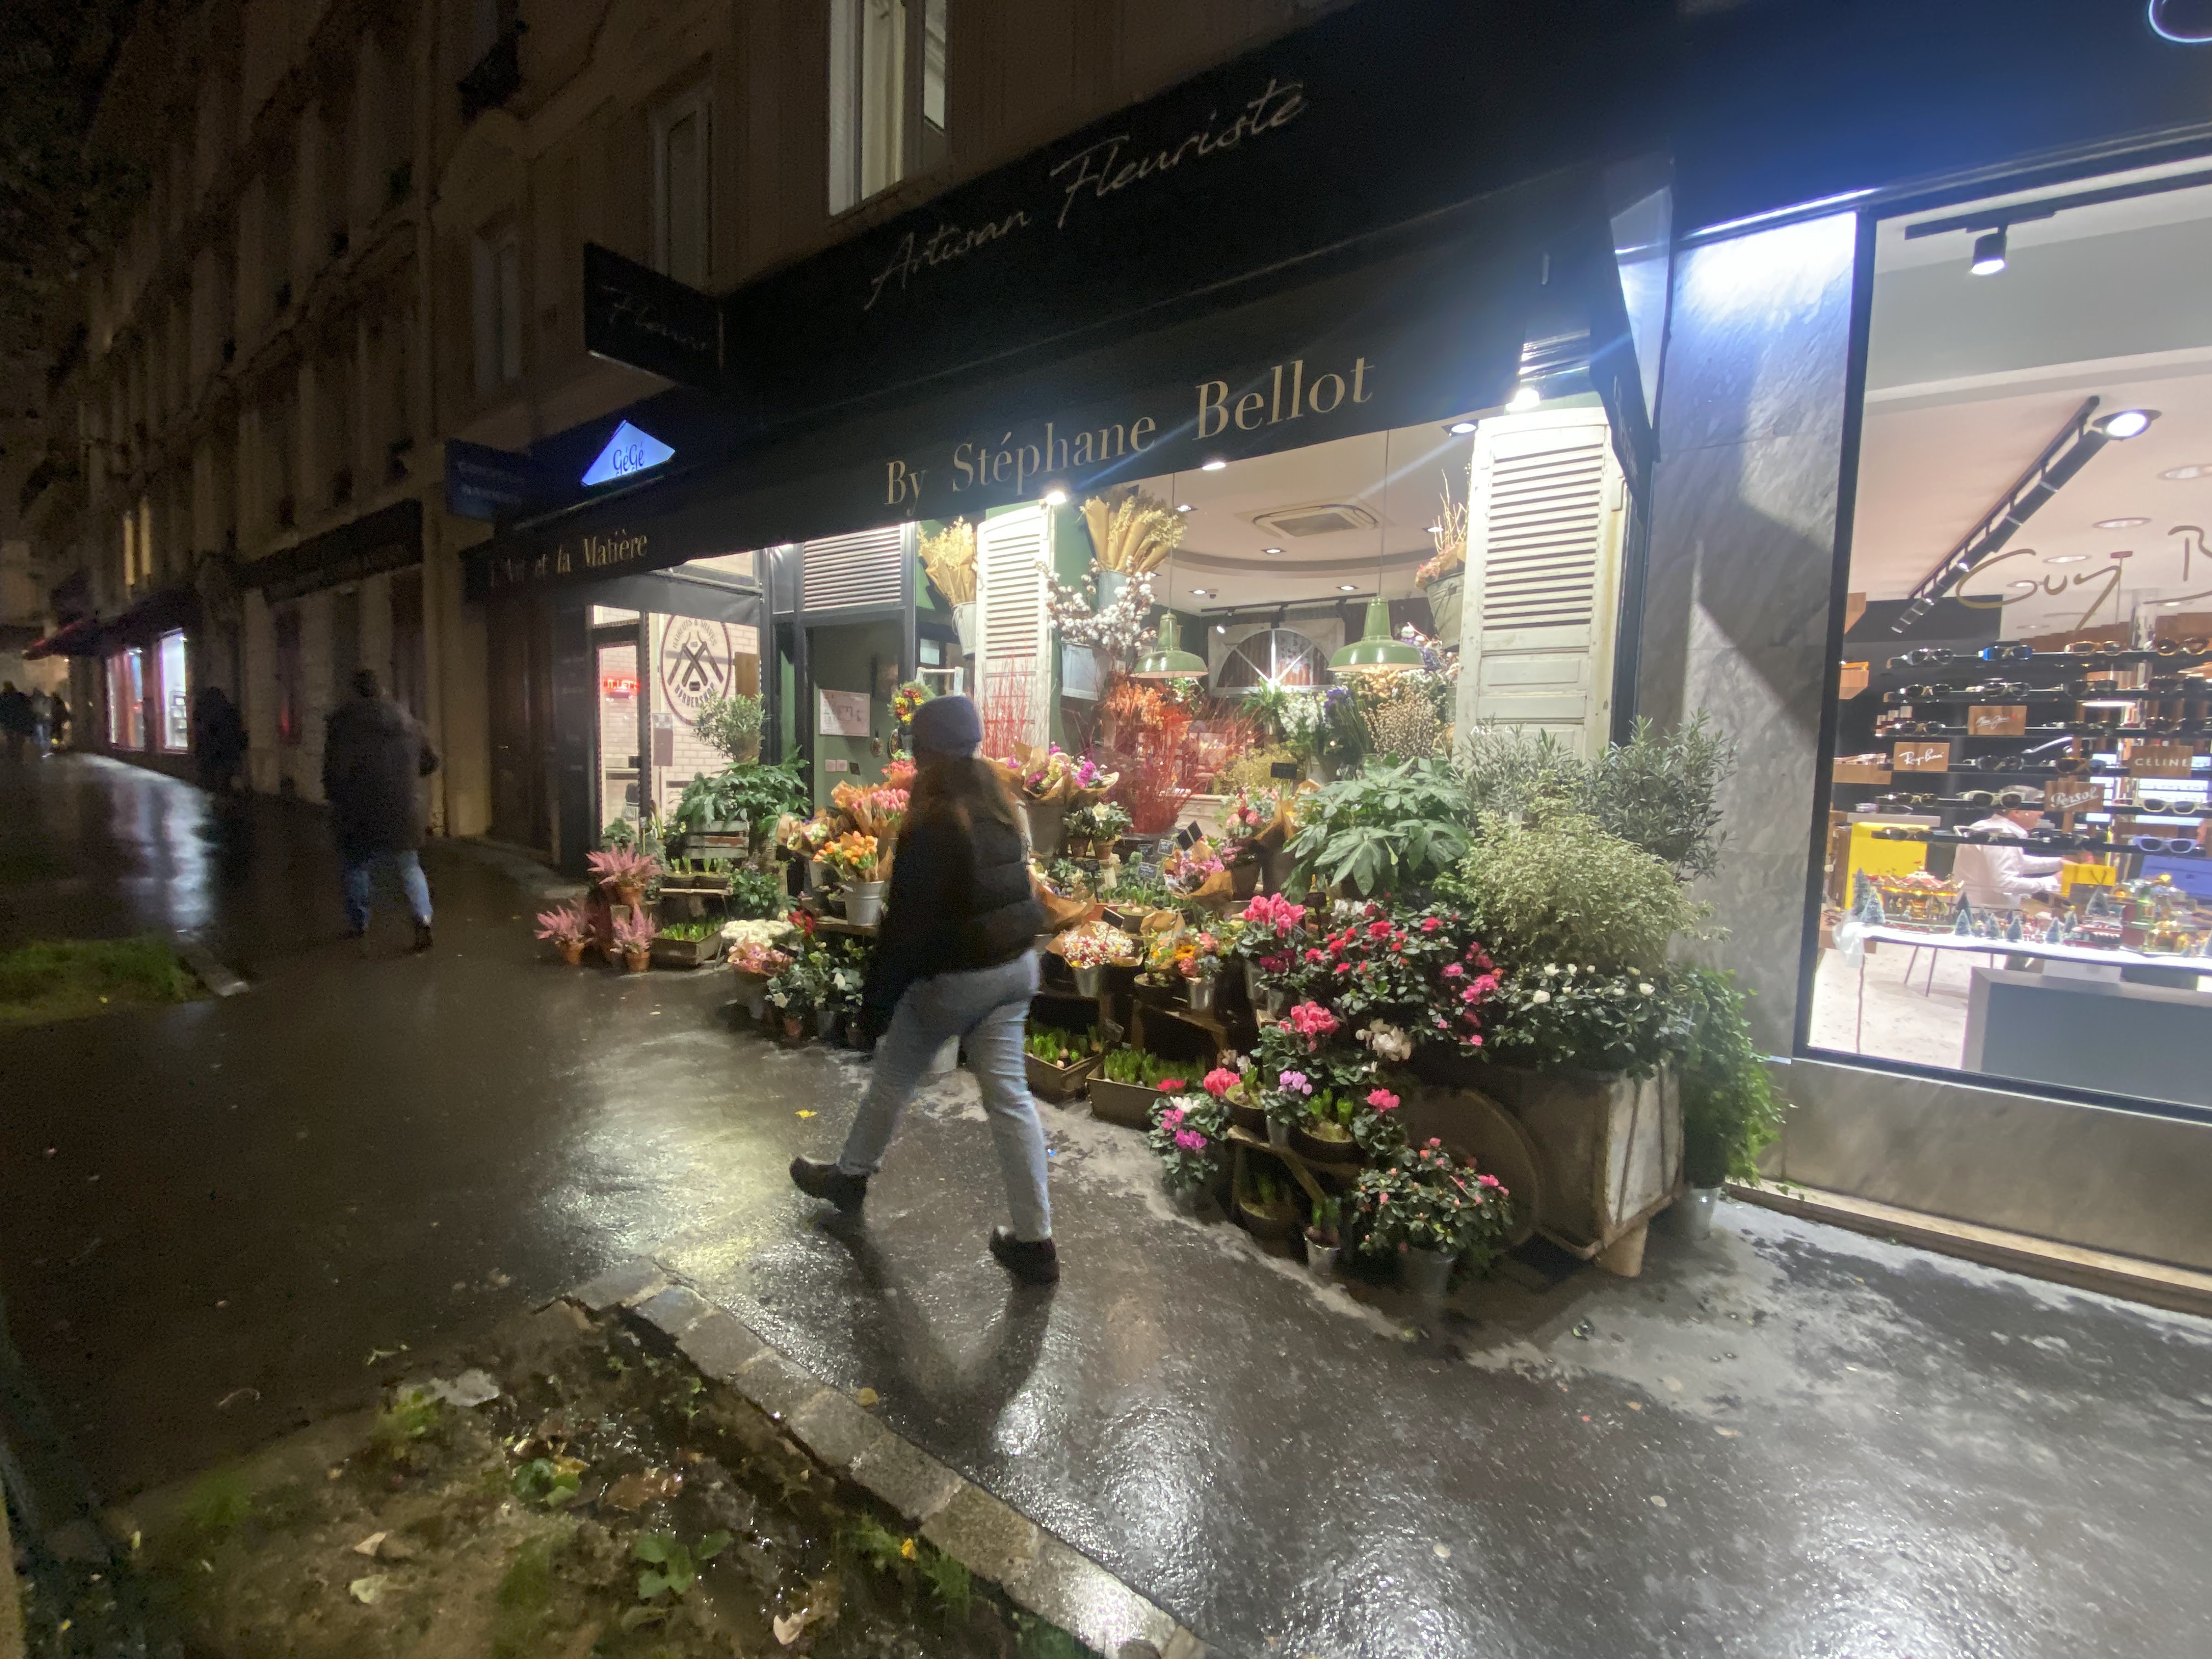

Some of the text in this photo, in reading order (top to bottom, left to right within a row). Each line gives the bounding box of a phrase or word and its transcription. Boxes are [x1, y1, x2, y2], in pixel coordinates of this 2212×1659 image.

[864, 78, 1307, 311] Artisan Fleuriste
[884, 357, 1376, 516] By Stéphane Bellot
[557, 545, 572, 573] la
[583, 528, 648, 567] Matière
[1956, 549, 2121, 630] Guy
[2050, 787, 2099, 808] Persol
